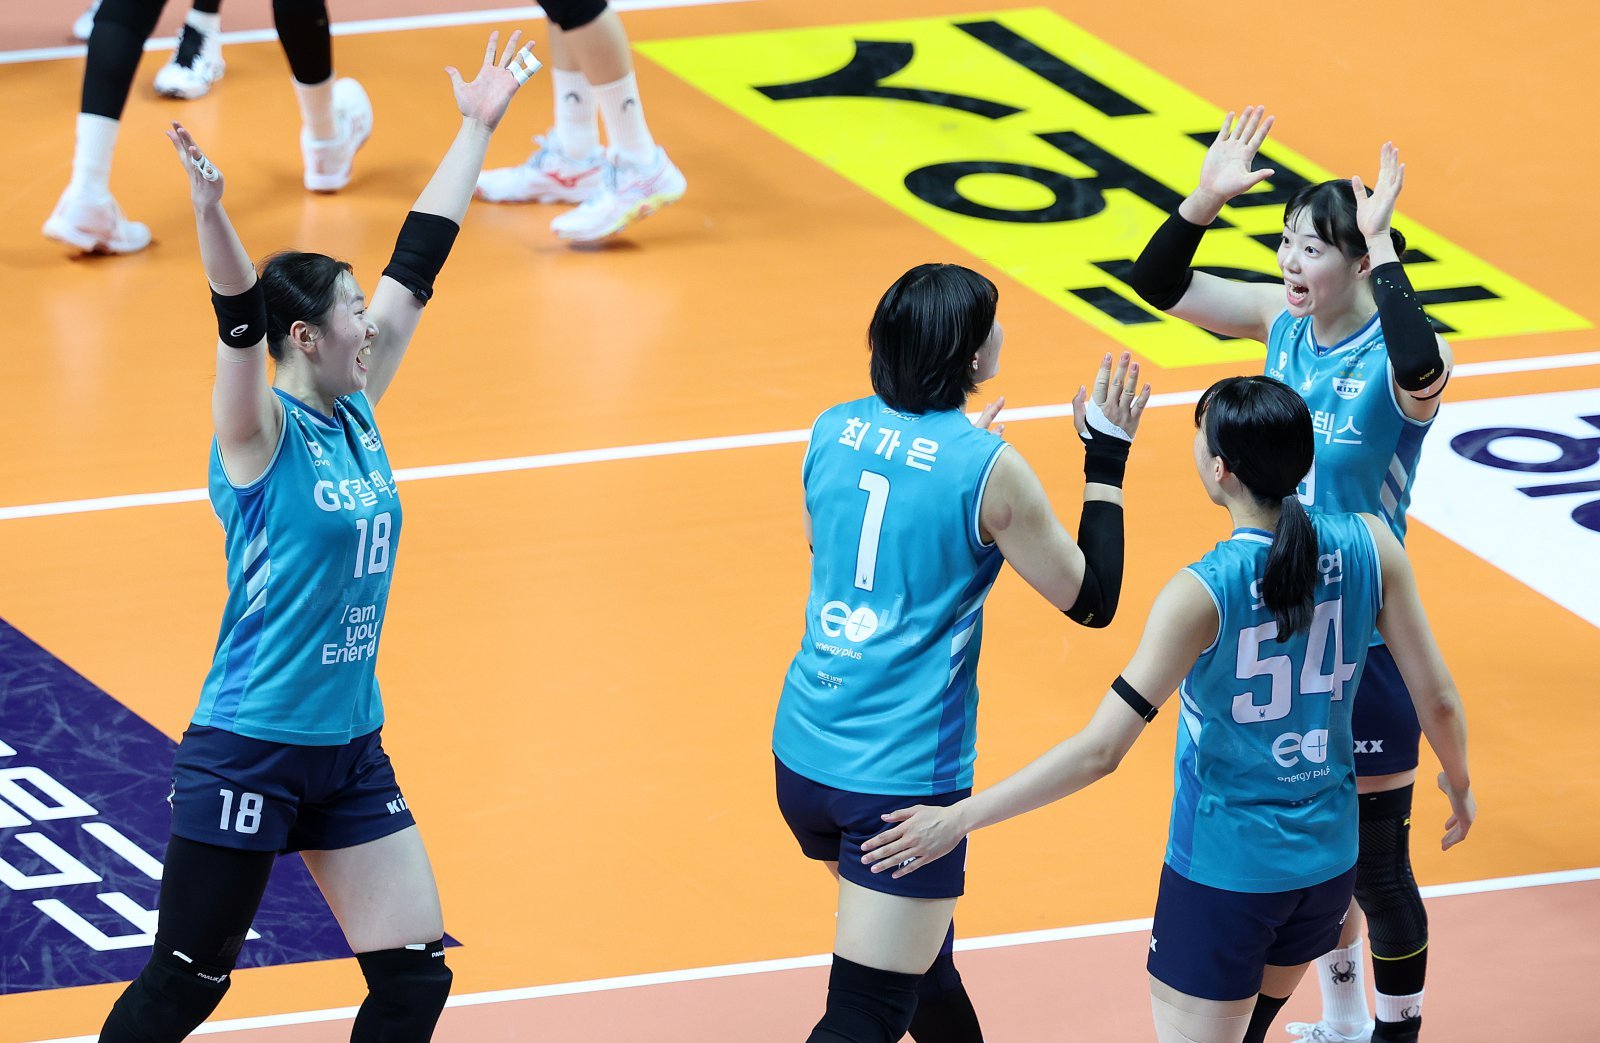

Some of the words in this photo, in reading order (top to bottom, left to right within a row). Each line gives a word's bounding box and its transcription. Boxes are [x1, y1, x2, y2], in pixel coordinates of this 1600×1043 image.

[1308, 409, 1362, 445] 텍스
[354, 511, 392, 579] 18
[854, 468, 891, 592] 1
[349, 604, 375, 624] am
[345, 619, 380, 647] you
[815, 641, 842, 656] energy
[841, 648, 863, 660] plus
[1231, 595, 1357, 724] 54
[1277, 770, 1312, 783] energy
[219, 788, 264, 835] 18
